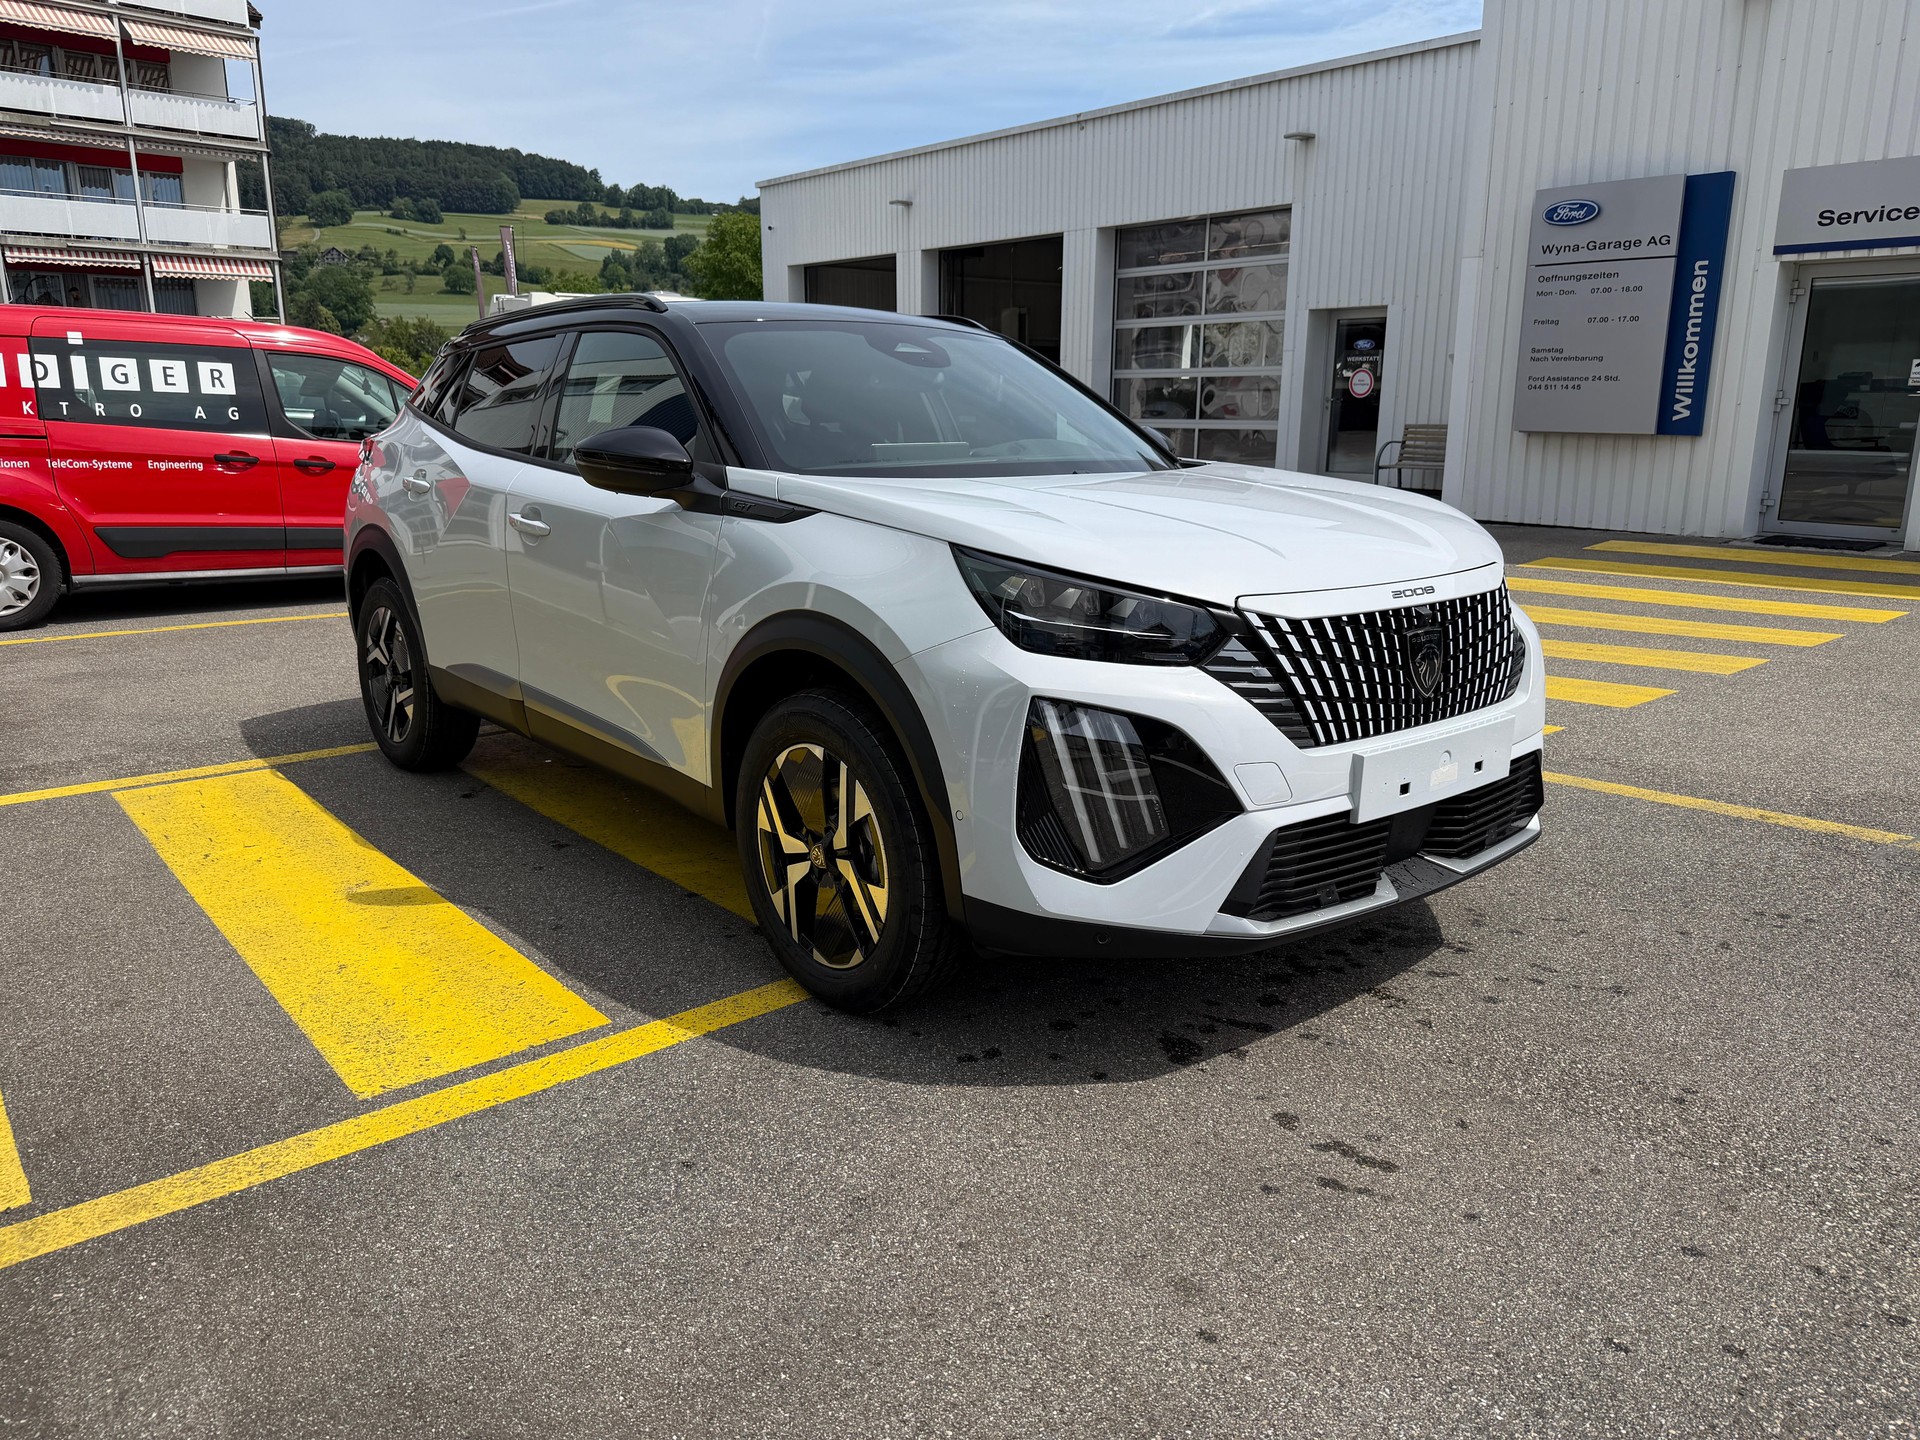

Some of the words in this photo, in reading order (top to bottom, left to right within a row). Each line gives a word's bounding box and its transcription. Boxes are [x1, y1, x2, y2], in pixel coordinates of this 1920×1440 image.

[1552, 203, 1588, 220] Ford
[1817, 205, 1920, 226] Service
[1541, 238, 1642, 256] Wyna-Garage
[1647, 234, 1671, 247] AG
[1537, 271, 1620, 284] Oeffnungszeiten
[1621, 285, 1643, 293] 18.00
[1533, 318, 1560, 326] Freitag
[1618, 315, 1640, 323] 17.00
[1672, 260, 1709, 421] Willkommen
[46, 458, 133, 471] TeleCom-Systeme
[147, 459, 204, 471] Engineering
[734, 501, 755, 512] GT
[1391, 586, 1435, 599] 2008
